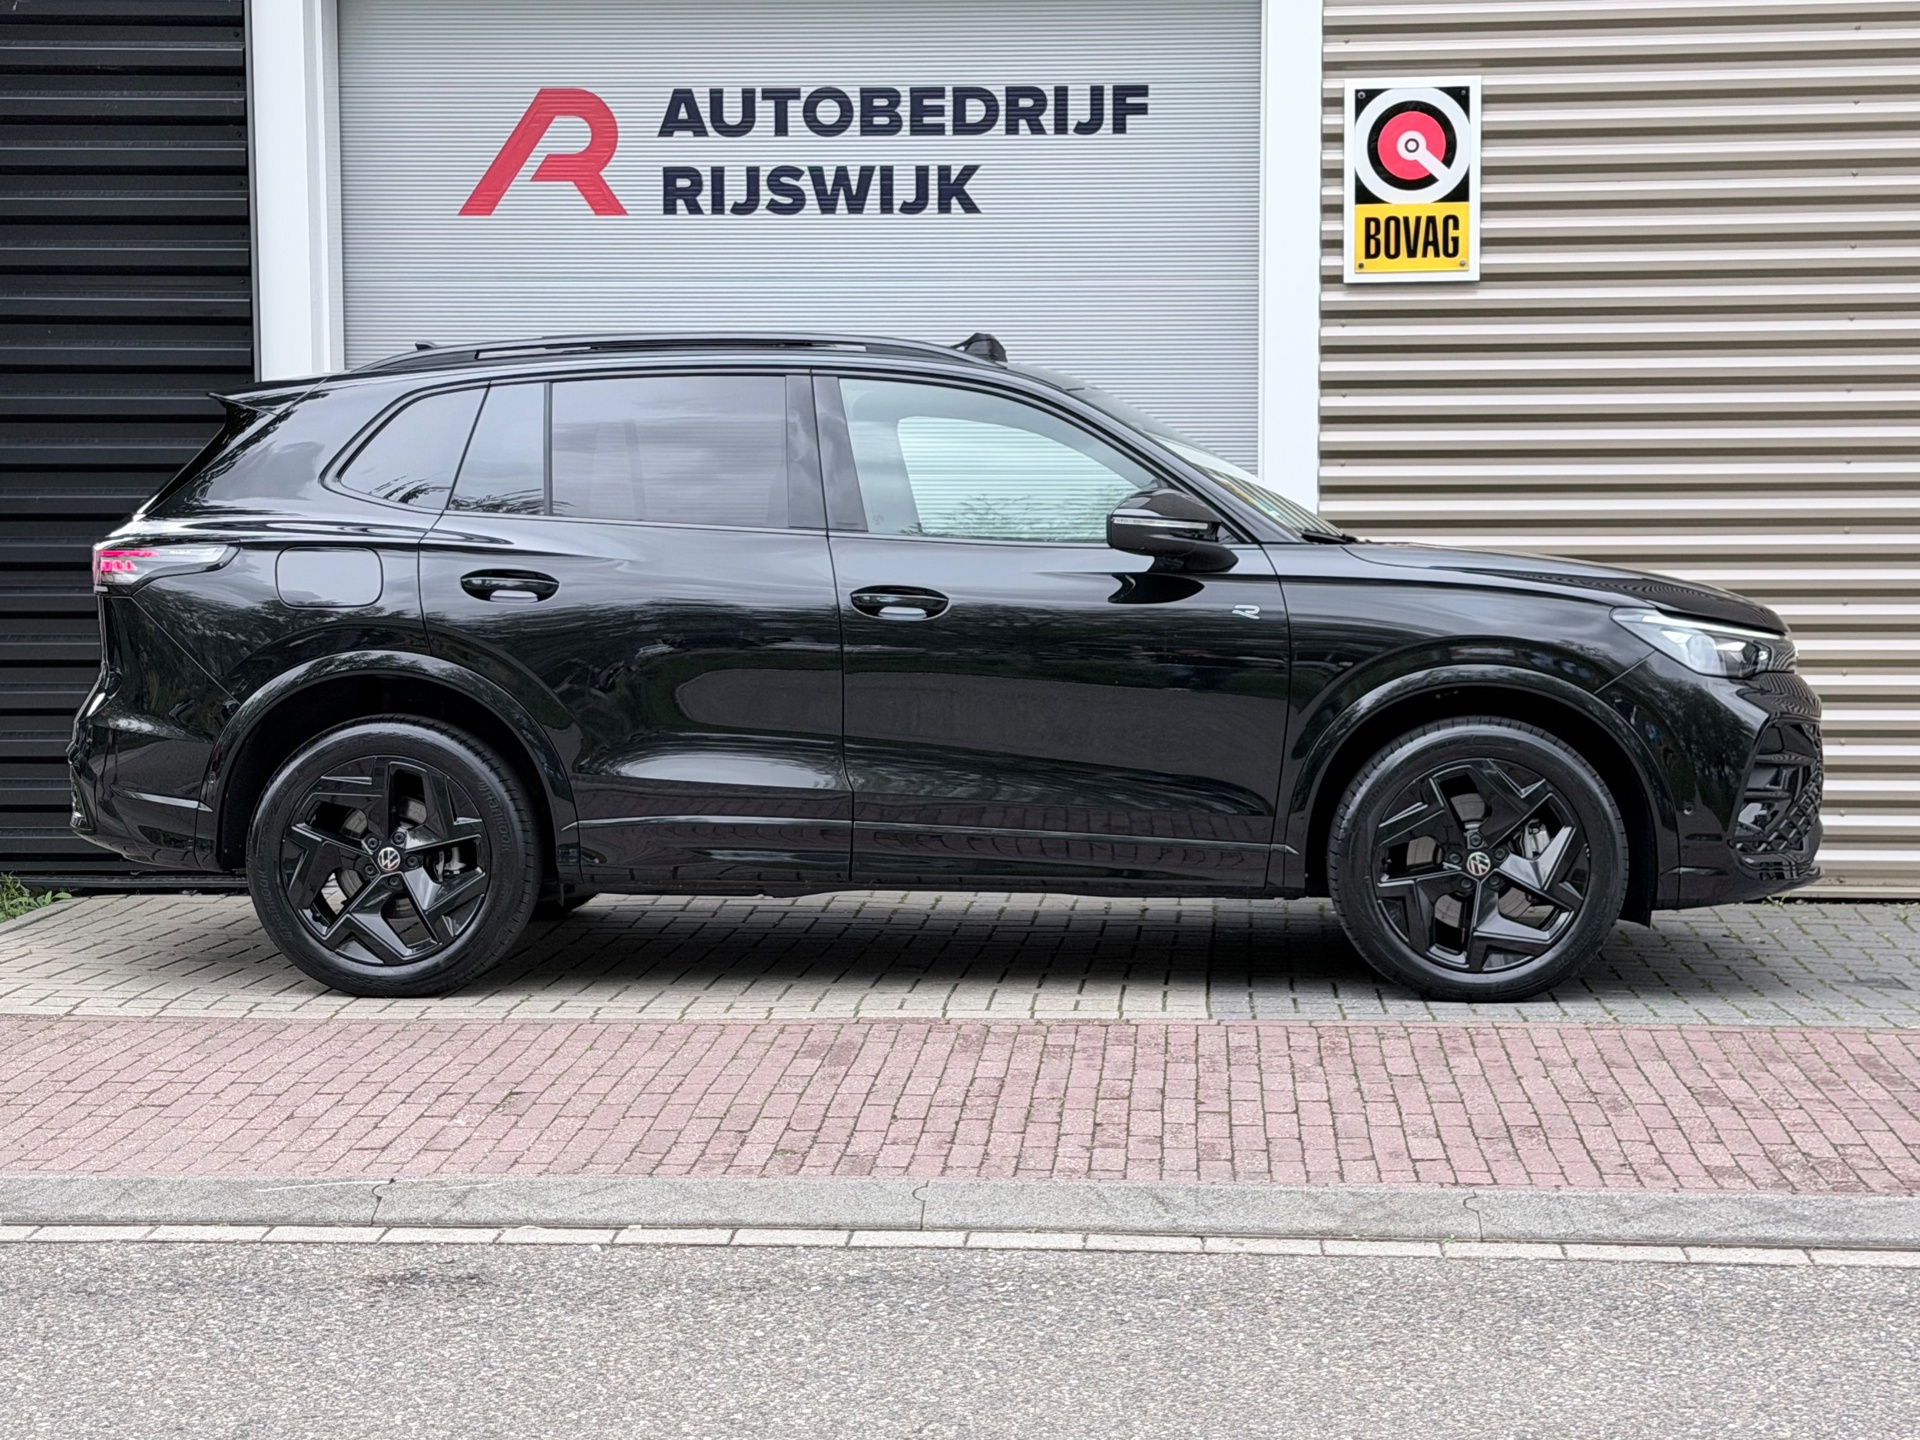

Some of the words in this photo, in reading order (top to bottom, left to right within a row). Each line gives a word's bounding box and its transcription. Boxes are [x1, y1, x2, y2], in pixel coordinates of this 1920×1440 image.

[657, 84, 1149, 138] AUTOBEDRIJF
[661, 163, 982, 216] RIJSWIJK
[1363, 214, 1460, 260] BOVAG
